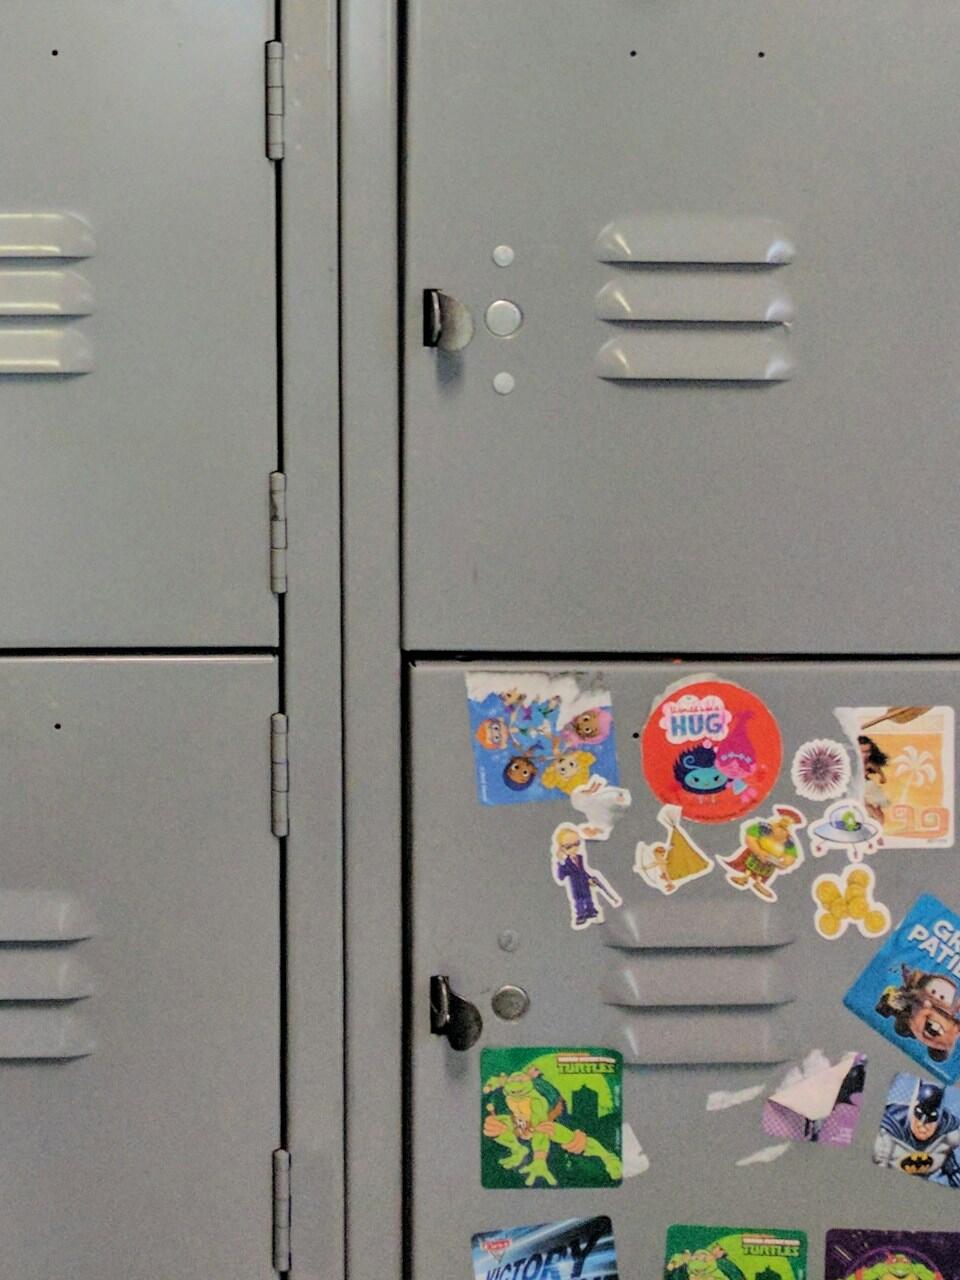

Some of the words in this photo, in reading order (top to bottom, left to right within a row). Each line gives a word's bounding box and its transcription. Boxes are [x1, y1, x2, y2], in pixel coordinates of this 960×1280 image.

[671, 713, 723, 736] HUG
[558, 1062, 615, 1074] TURTLES
[742, 1244, 800, 1257] TURTLES
